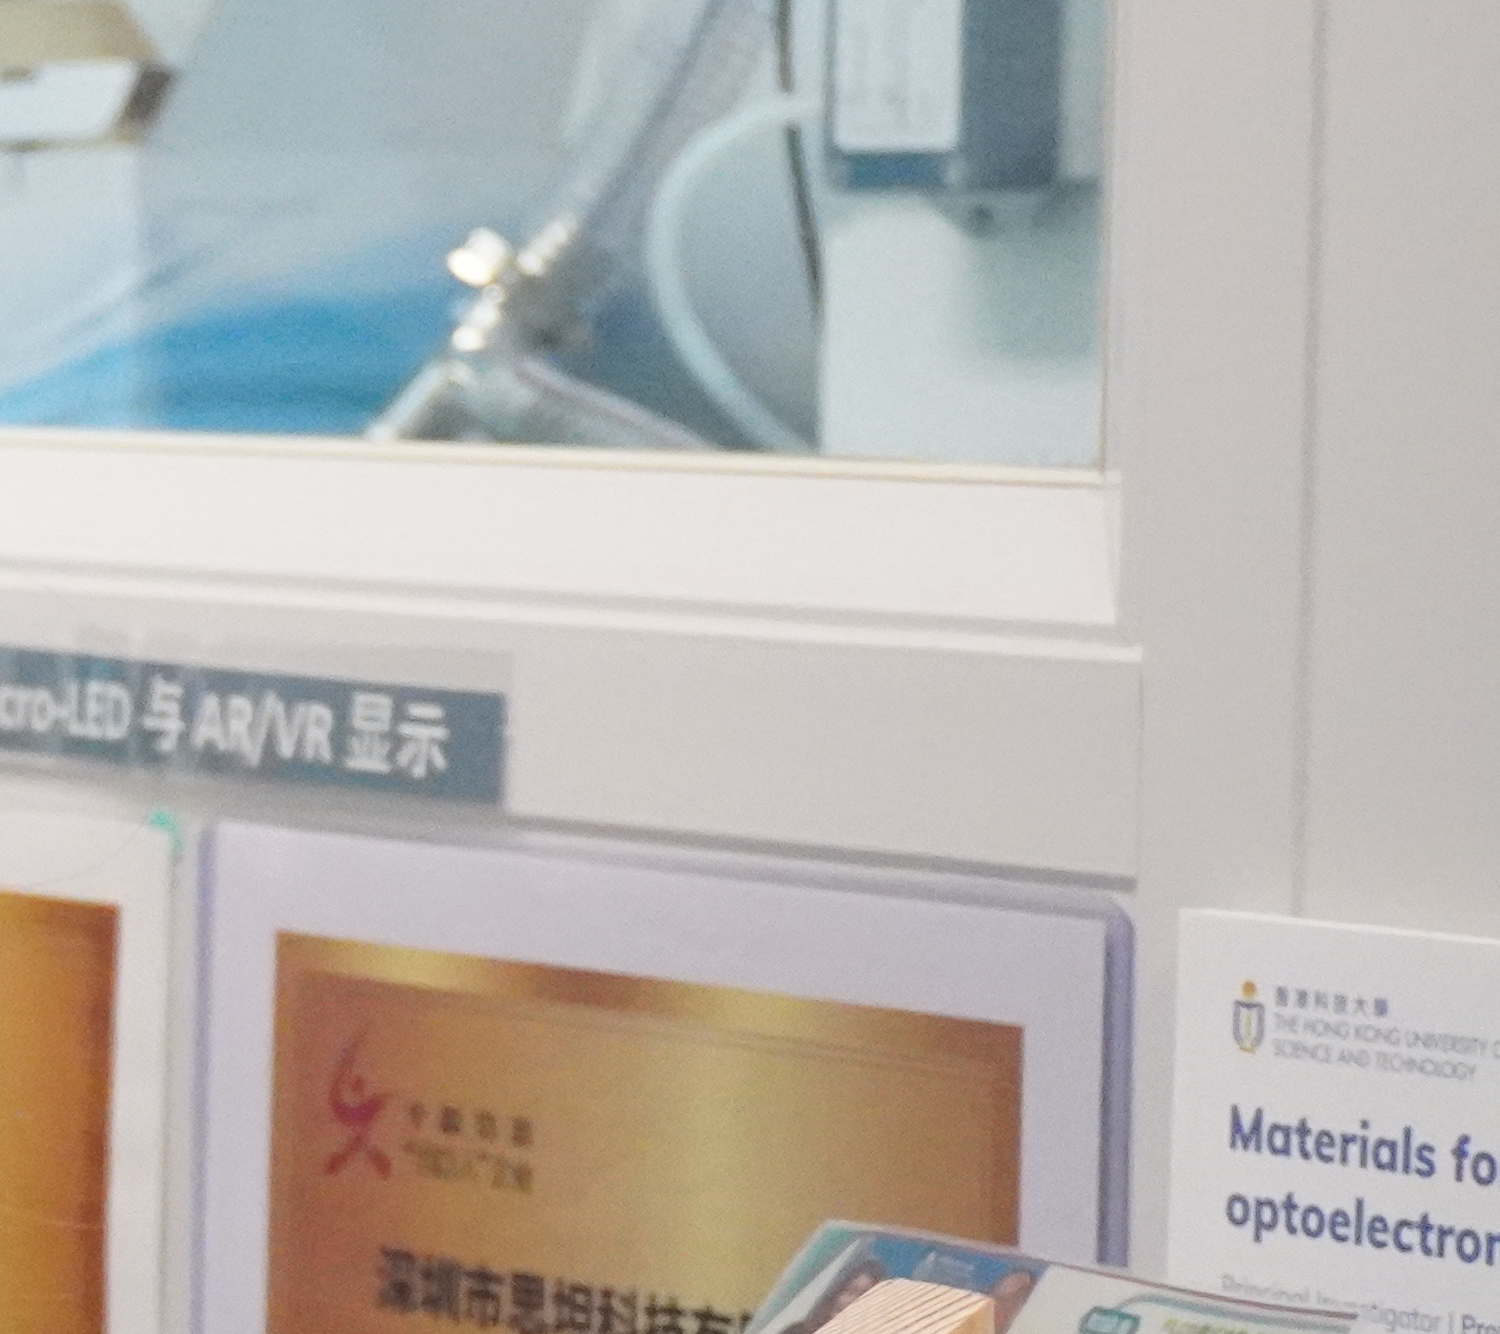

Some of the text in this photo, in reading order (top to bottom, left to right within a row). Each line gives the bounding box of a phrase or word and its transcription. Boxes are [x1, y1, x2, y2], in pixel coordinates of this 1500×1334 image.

[142, 675, 186, 754] 与
[190, 690, 334, 767] AR/VR
[346, 691, 450, 779] 显示
[1303, 1019, 1351, 1041] HONG
[1354, 1023, 1401, 1046] KONG
[1229, 1103, 1437, 1179] Materials
